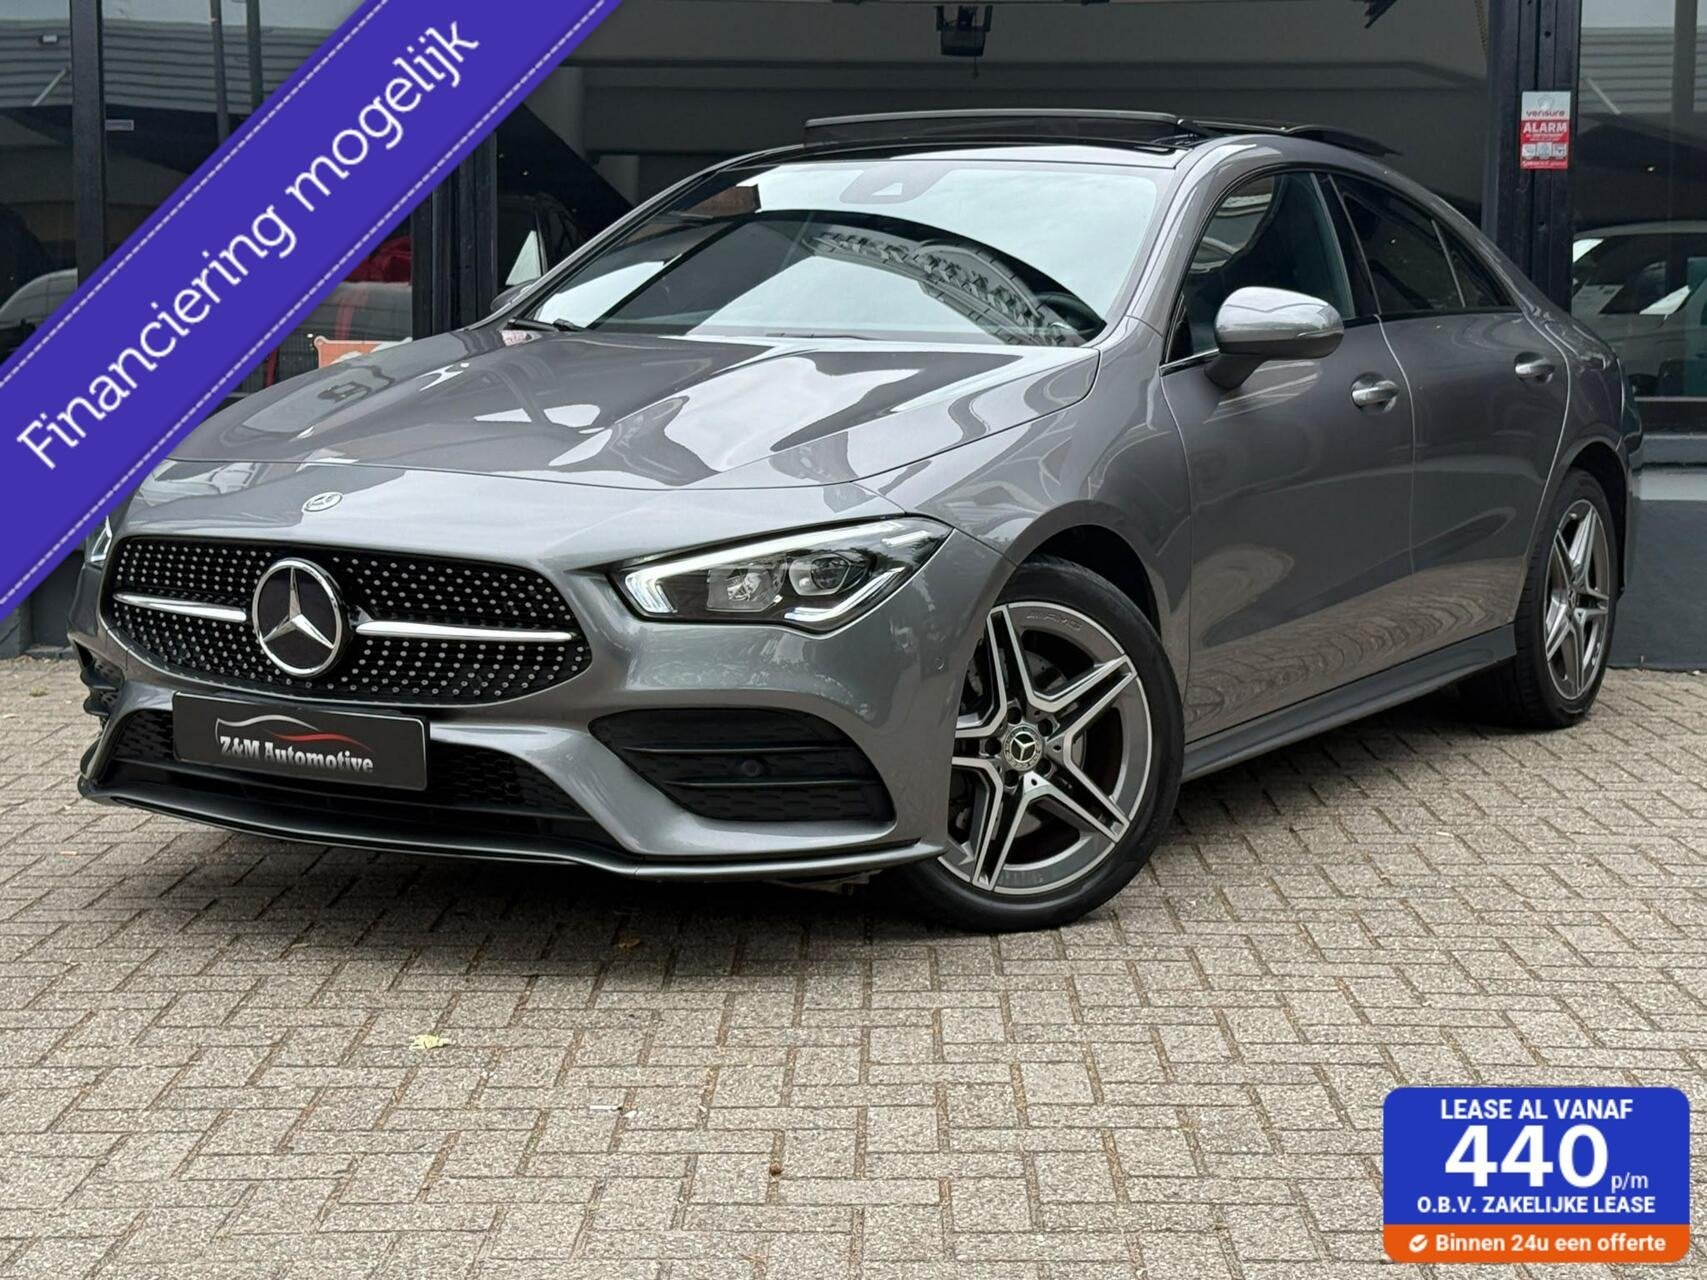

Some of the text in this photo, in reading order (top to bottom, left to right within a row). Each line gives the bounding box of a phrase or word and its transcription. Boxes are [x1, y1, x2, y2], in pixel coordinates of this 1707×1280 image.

[1523, 122, 1568, 133] ALARM
[220, 736, 374, 773] Z&M Automotive
